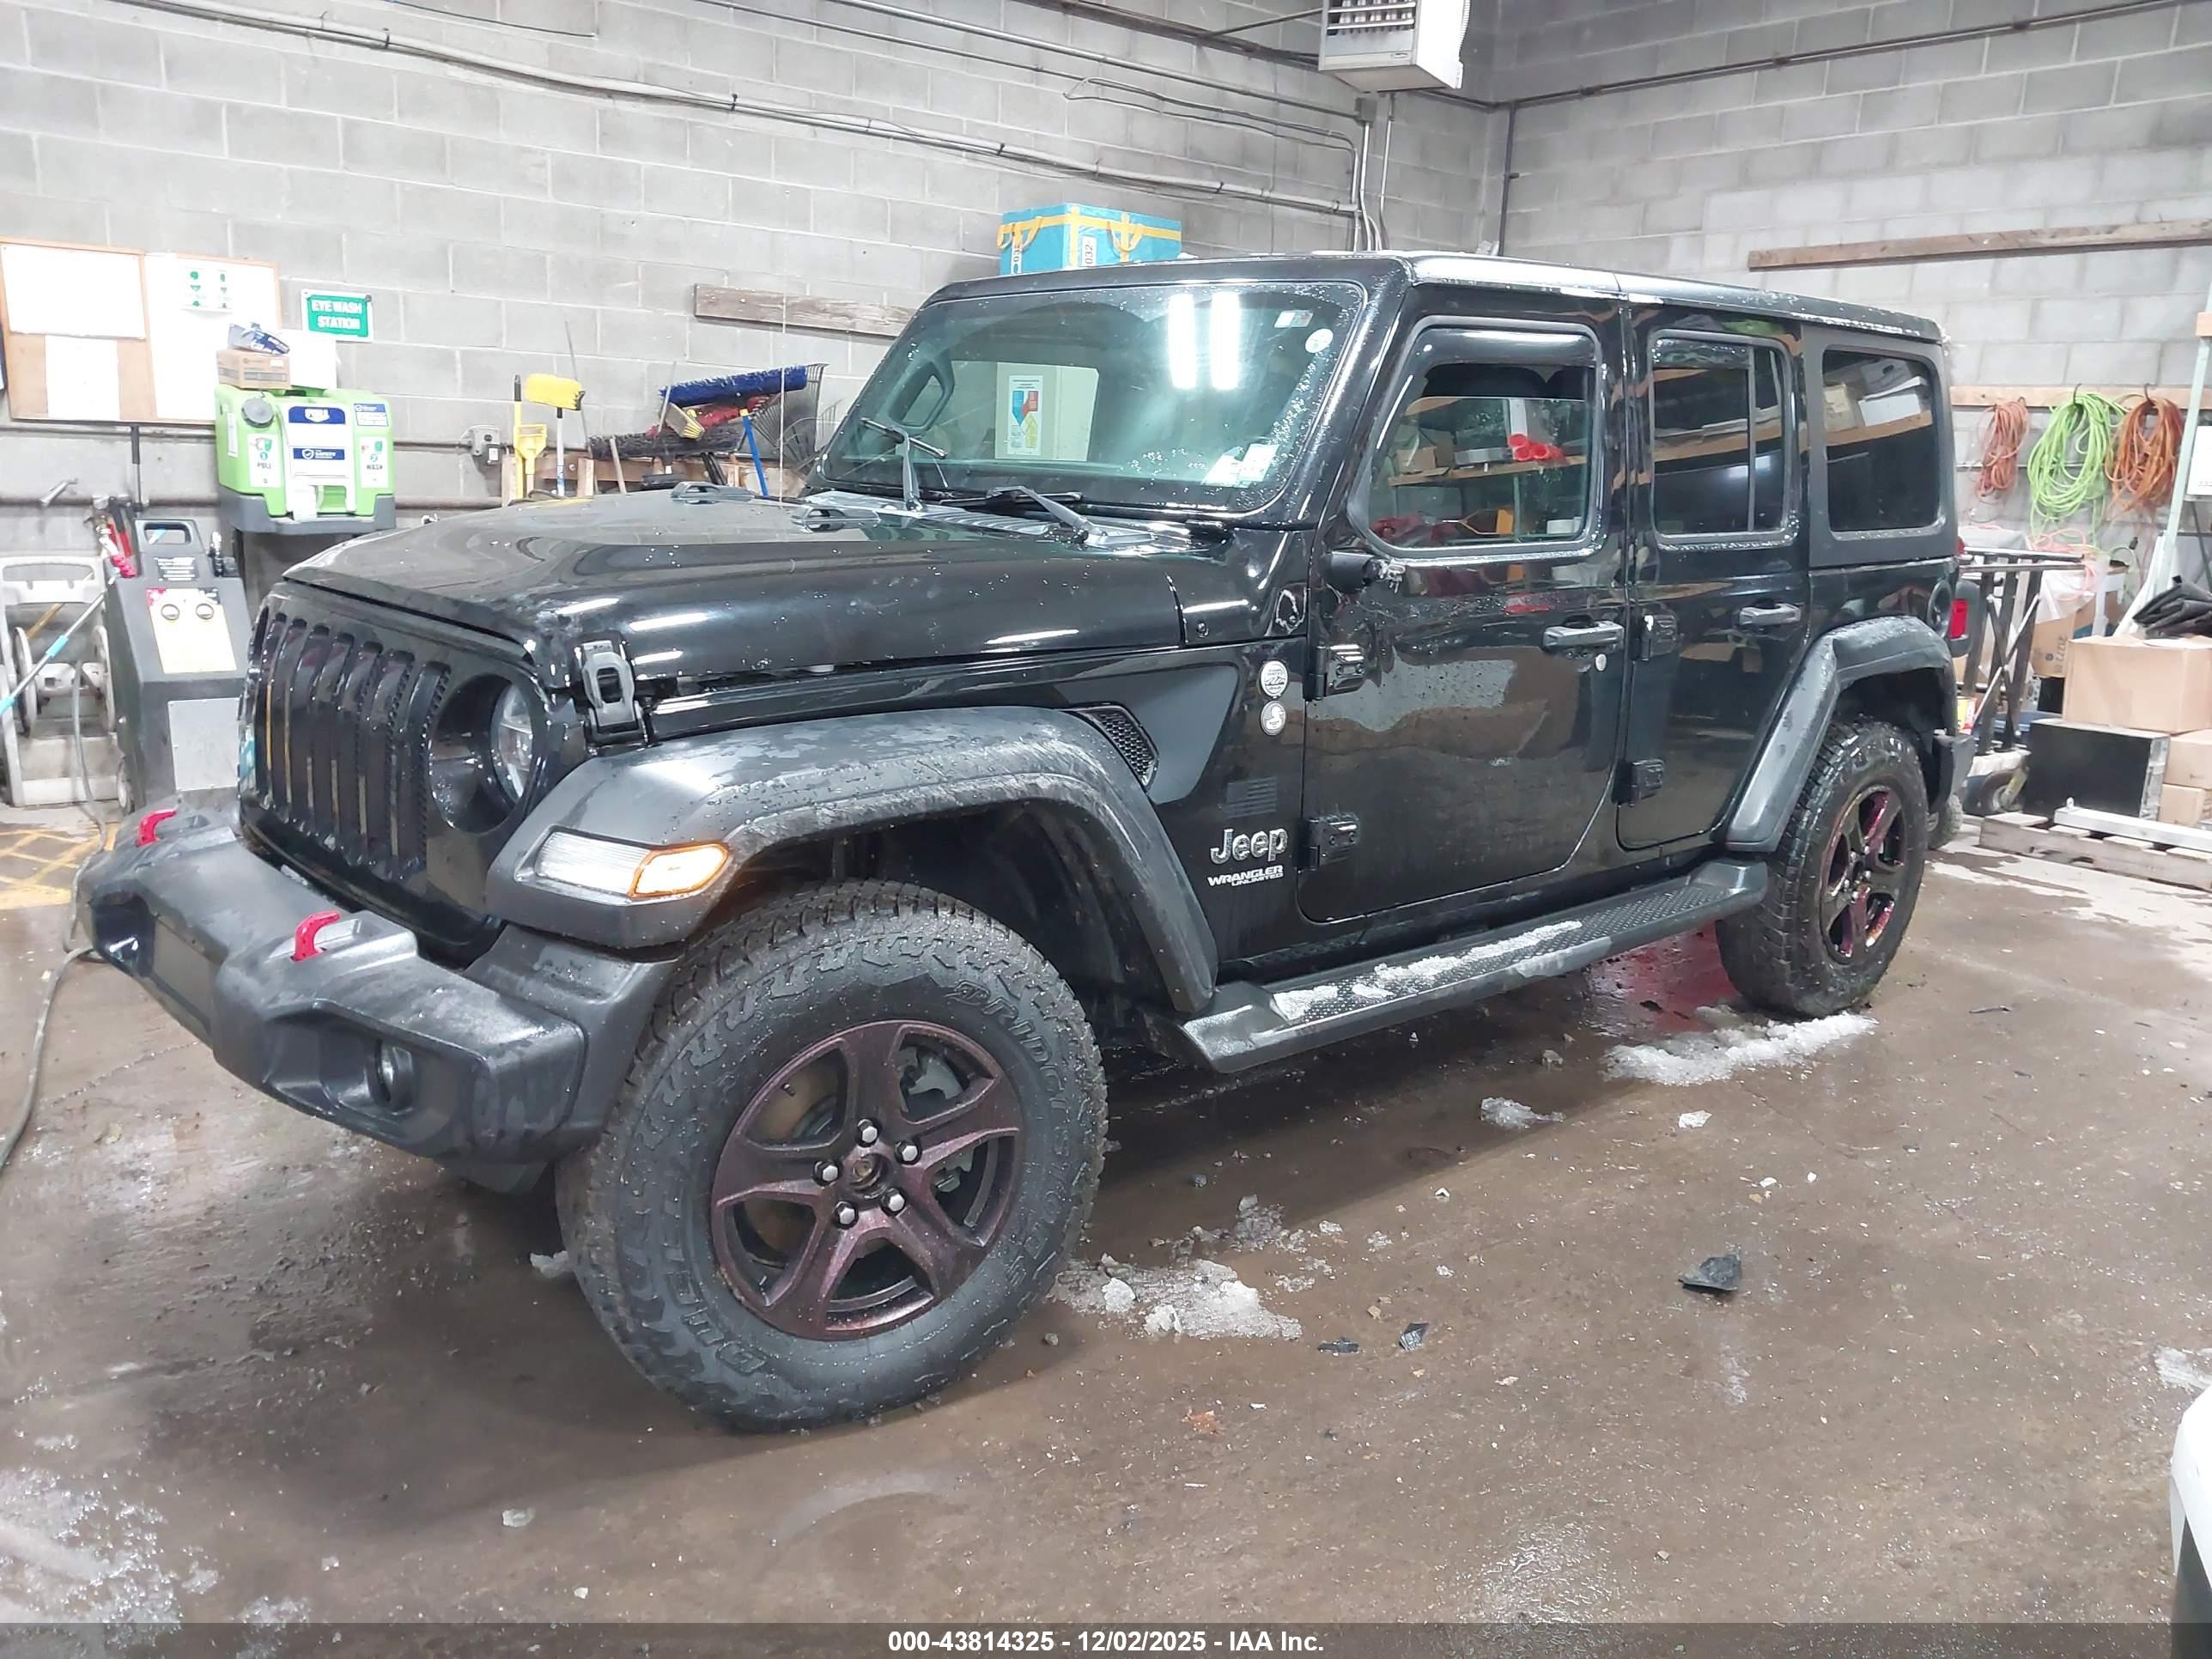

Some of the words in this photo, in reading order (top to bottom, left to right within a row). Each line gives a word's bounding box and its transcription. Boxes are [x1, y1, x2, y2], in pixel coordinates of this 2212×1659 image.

[312, 300, 331, 312] EYE
[332, 301, 362, 314] WASH
[317, 315, 361, 330] STATION
[1209, 828, 1289, 865] Jeep
[1207, 865, 1284, 886] WRANGLER
[1231, 872, 1284, 887] UNLIMITED
